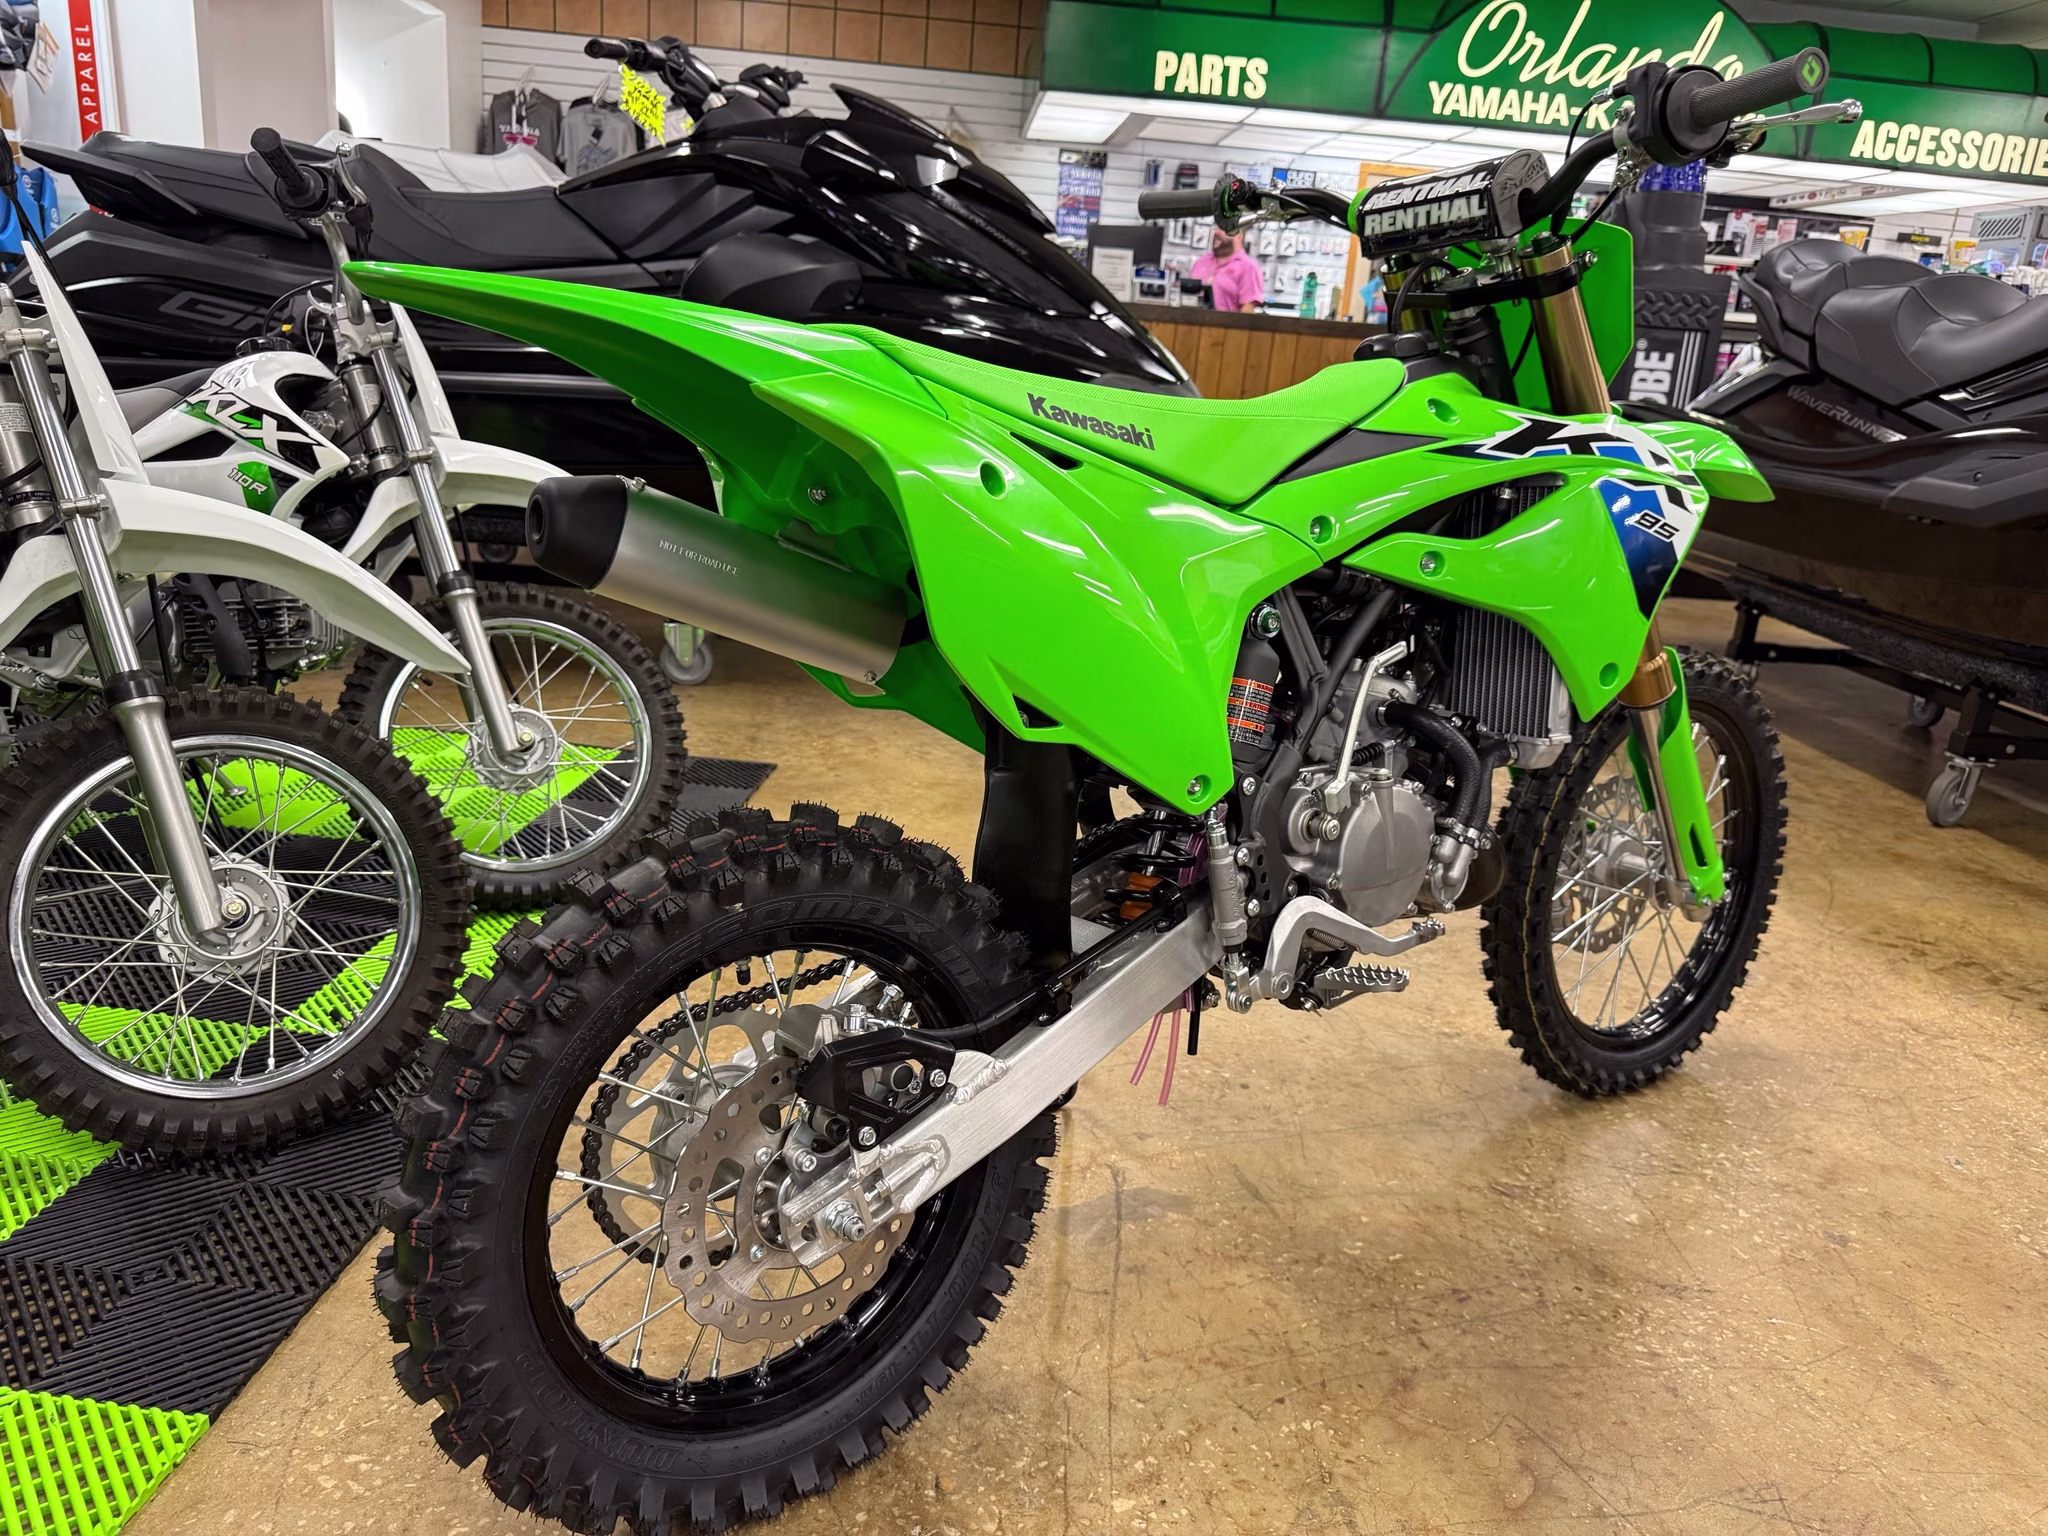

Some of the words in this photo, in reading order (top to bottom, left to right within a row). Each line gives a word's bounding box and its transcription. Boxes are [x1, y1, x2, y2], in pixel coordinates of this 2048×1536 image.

[75, 24, 99, 124] APPAREL
[1153, 50, 1269, 100] PARTS
[1428, 81, 1640, 131] YAMAHA-K
[1363, 171, 1490, 212] RENTHAL
[1364, 194, 1488, 236] RENTHAL
[186, 381, 320, 459] KLX
[1027, 392, 1155, 451] Kawasaki
[228, 467, 269, 495] 110R
[1634, 511, 1681, 541] 85
[659, 539, 678, 553] NOT
[679, 547, 698, 561] FOR
[698, 554, 721, 569] ROAD
[722, 563, 740, 576] USE
